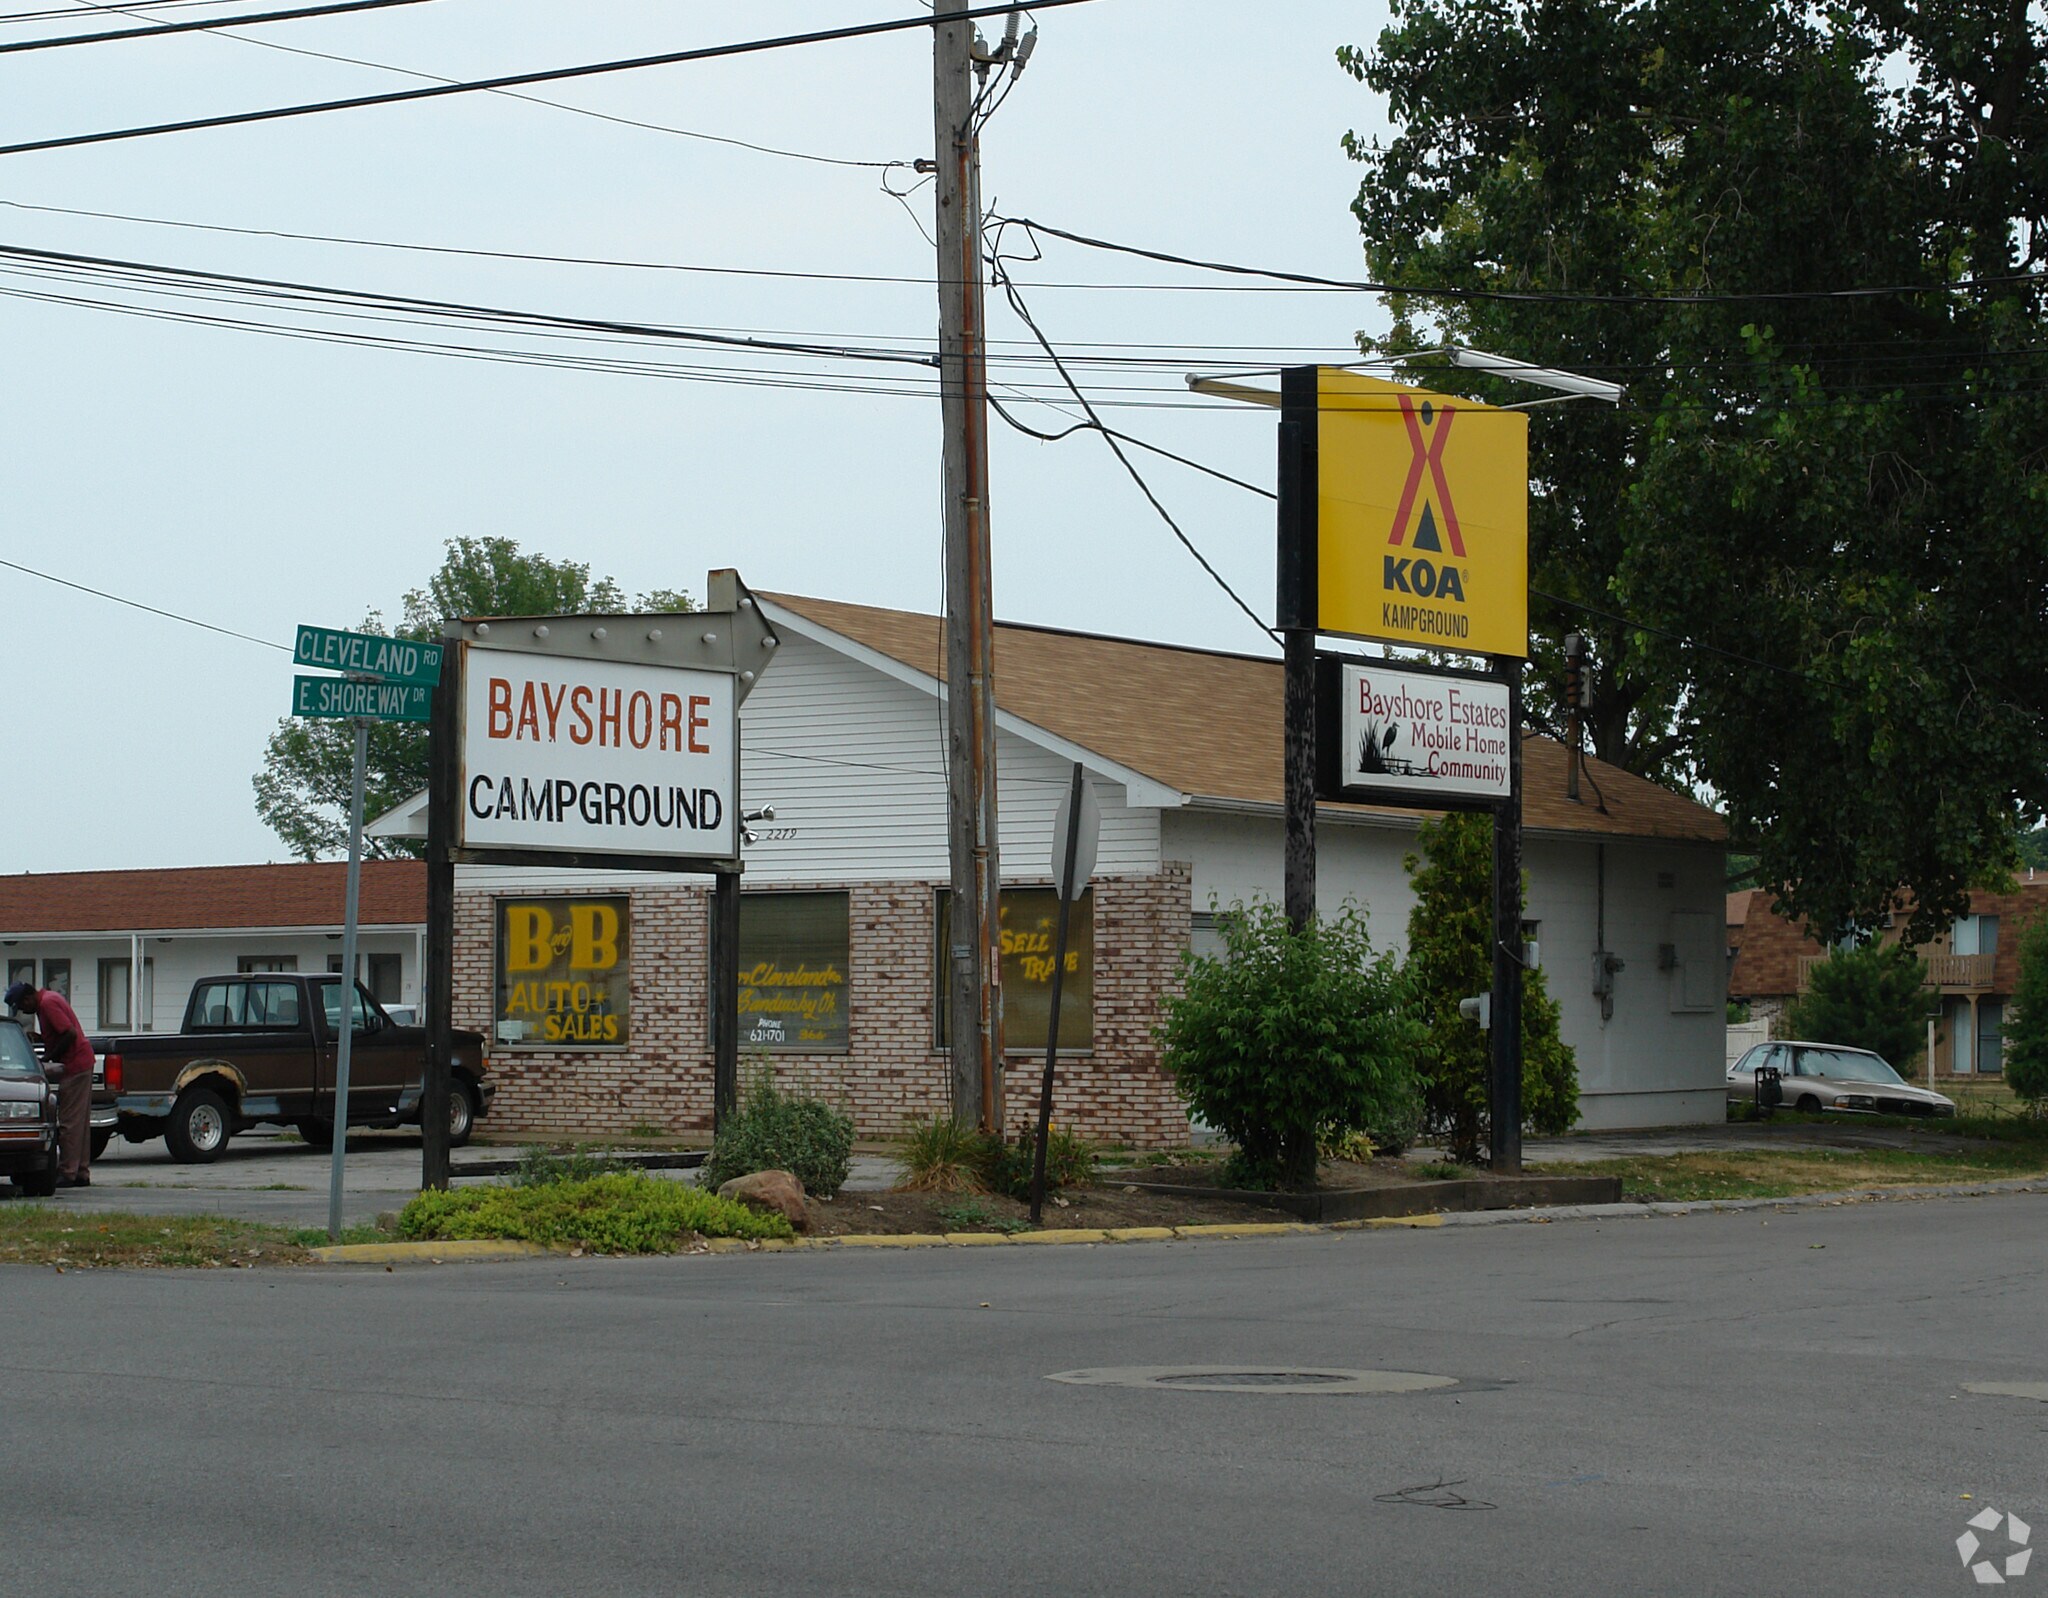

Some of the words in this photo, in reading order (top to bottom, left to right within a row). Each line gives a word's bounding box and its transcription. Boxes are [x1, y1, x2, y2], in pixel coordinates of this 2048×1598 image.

[1383, 555, 1465, 602] KOA
[1383, 602, 1468, 638] KAMPGROUND
[299, 631, 417, 676] CLEVELAND
[423, 650, 438, 666] RD
[300, 682, 315, 711] E.
[319, 682, 409, 715] SHOREWAY
[413, 688, 425, 702] DR
[488, 678, 711, 754] BAYSHORE
[1359, 678, 1443, 724] Bayshore
[1448, 689, 1506, 729] Estates
[1411, 722, 1461, 751] Mobile
[1466, 727, 1506, 755] Home
[1428, 751, 1506, 787] Community
[469, 774, 722, 830] CAMPGROUND
[766, 828, 797, 840] 2279
[506, 905, 553, 972] B
[569, 905, 618, 970] B
[1000, 929, 1049, 955] SELL
[505, 981, 590, 1013] AUTO
[544, 1014, 618, 1041] SALES
[757, 1018, 782, 1028] PHONE
